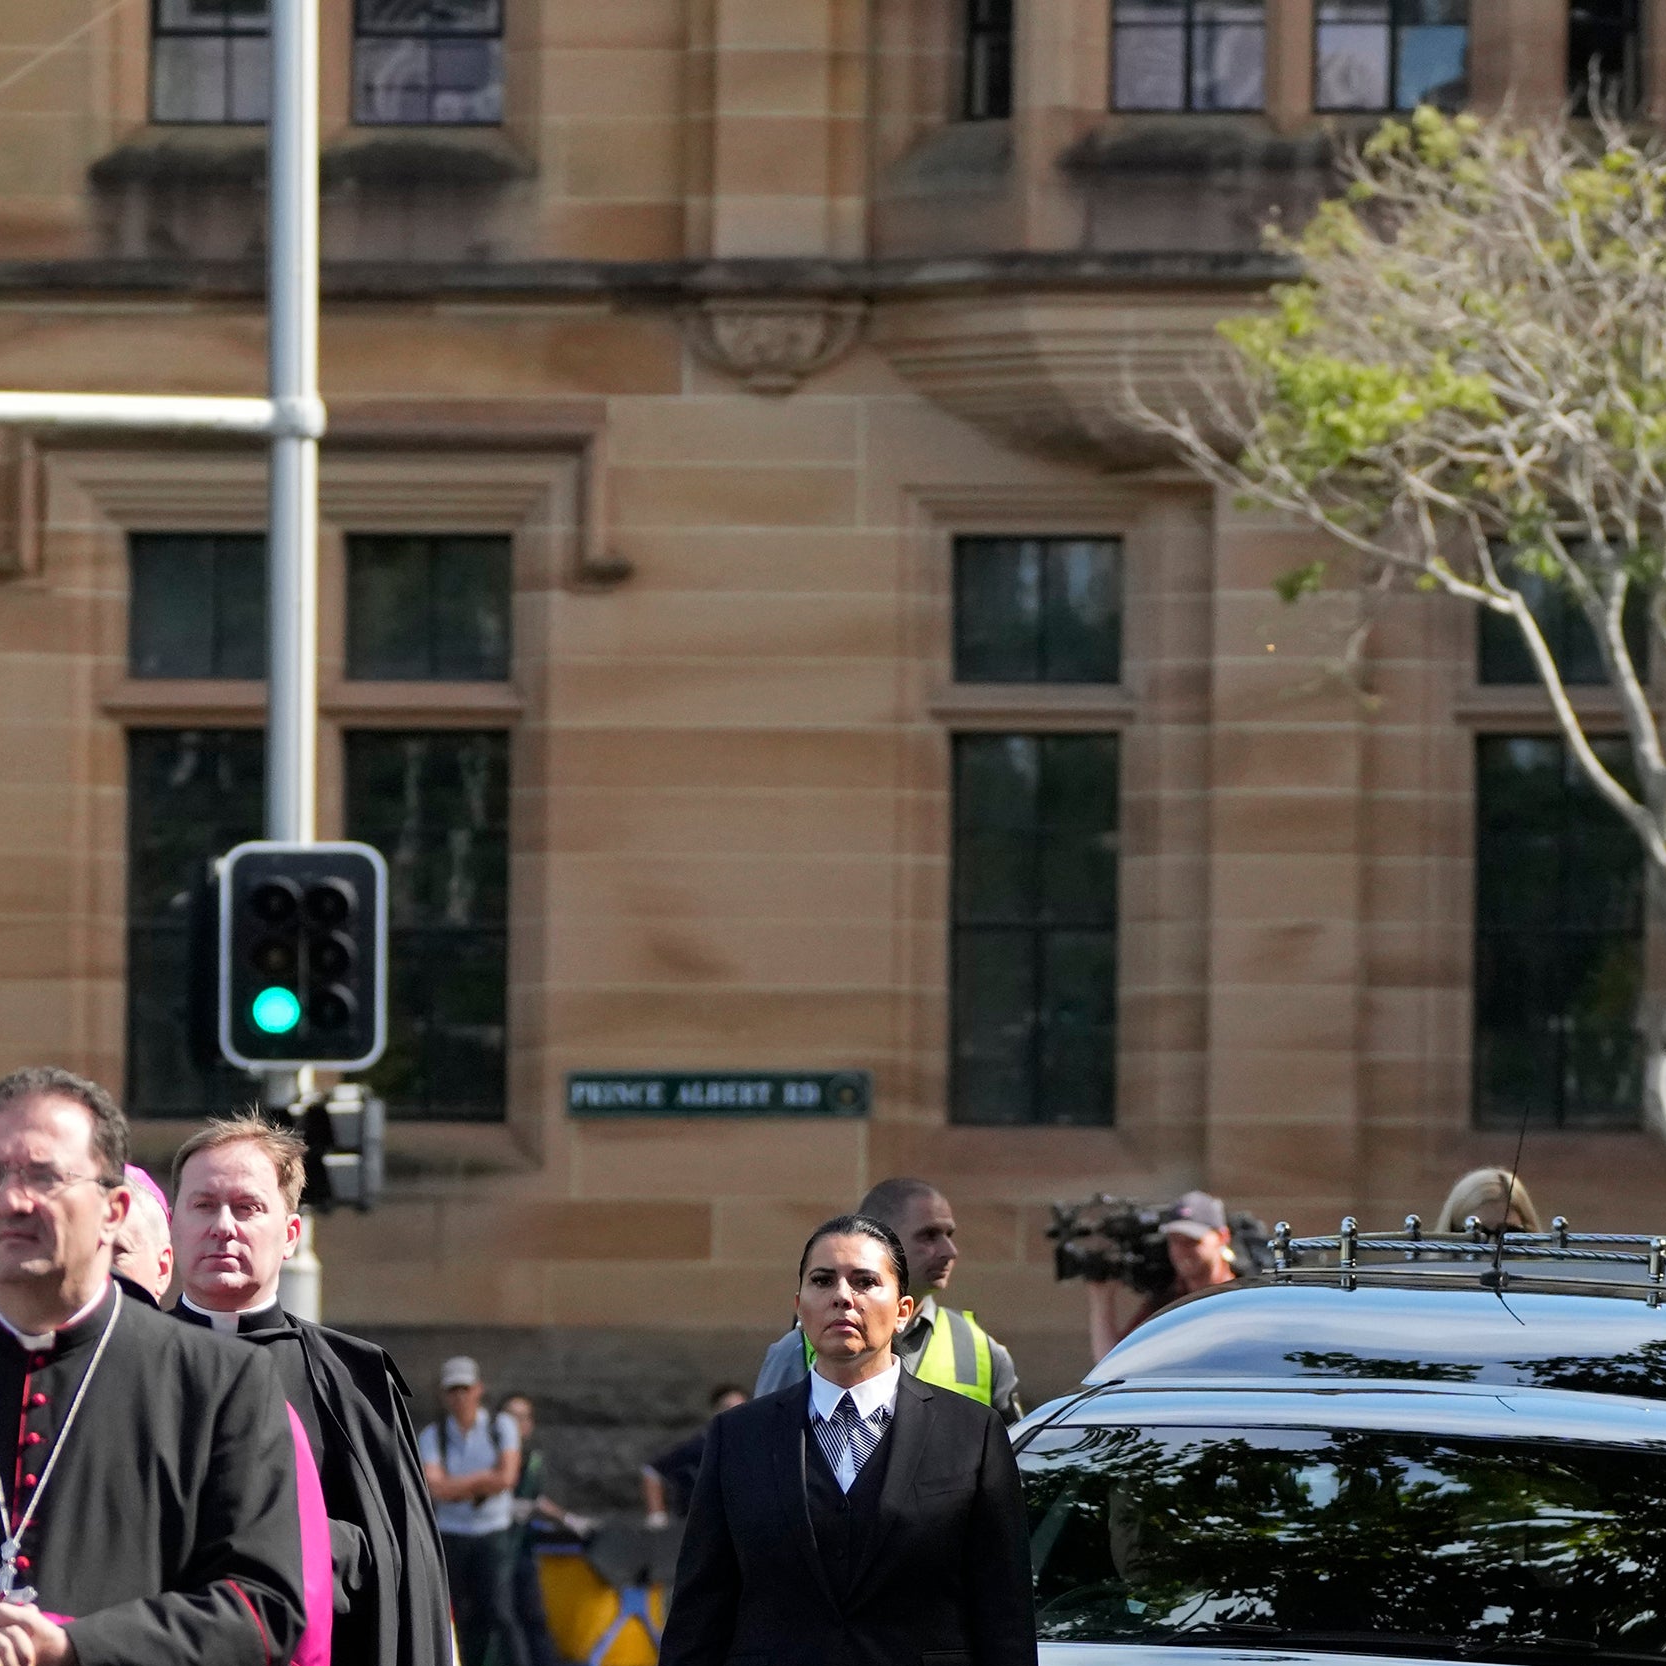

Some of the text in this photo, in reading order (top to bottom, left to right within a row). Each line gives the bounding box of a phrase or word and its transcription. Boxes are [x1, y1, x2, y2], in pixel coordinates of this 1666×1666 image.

[570, 1081, 821, 1106] PRINCE ALBERT RD
